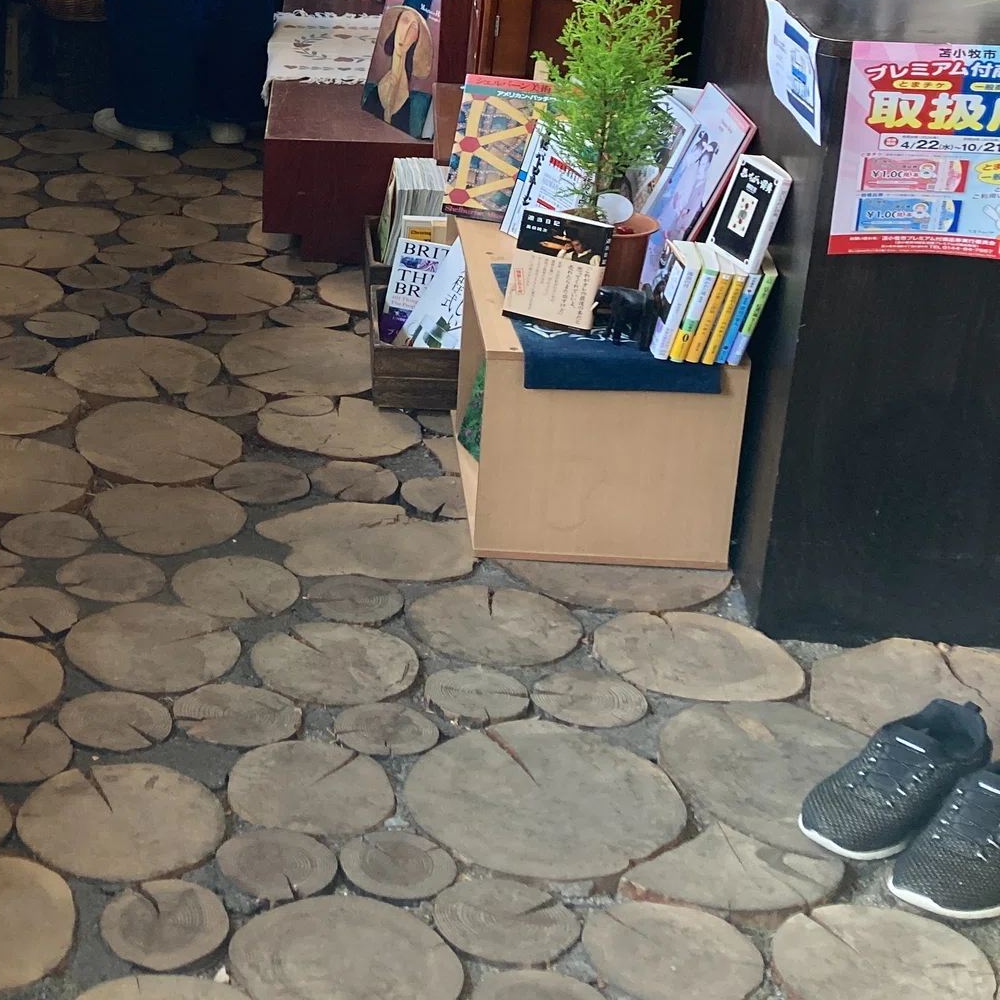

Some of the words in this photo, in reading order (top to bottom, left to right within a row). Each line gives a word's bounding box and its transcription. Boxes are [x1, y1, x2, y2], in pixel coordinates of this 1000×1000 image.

[939, 48, 997, 59] 苫小牧市
[899, 81, 946, 89] とまチケ
[867, 91, 1000, 132] 取扱
